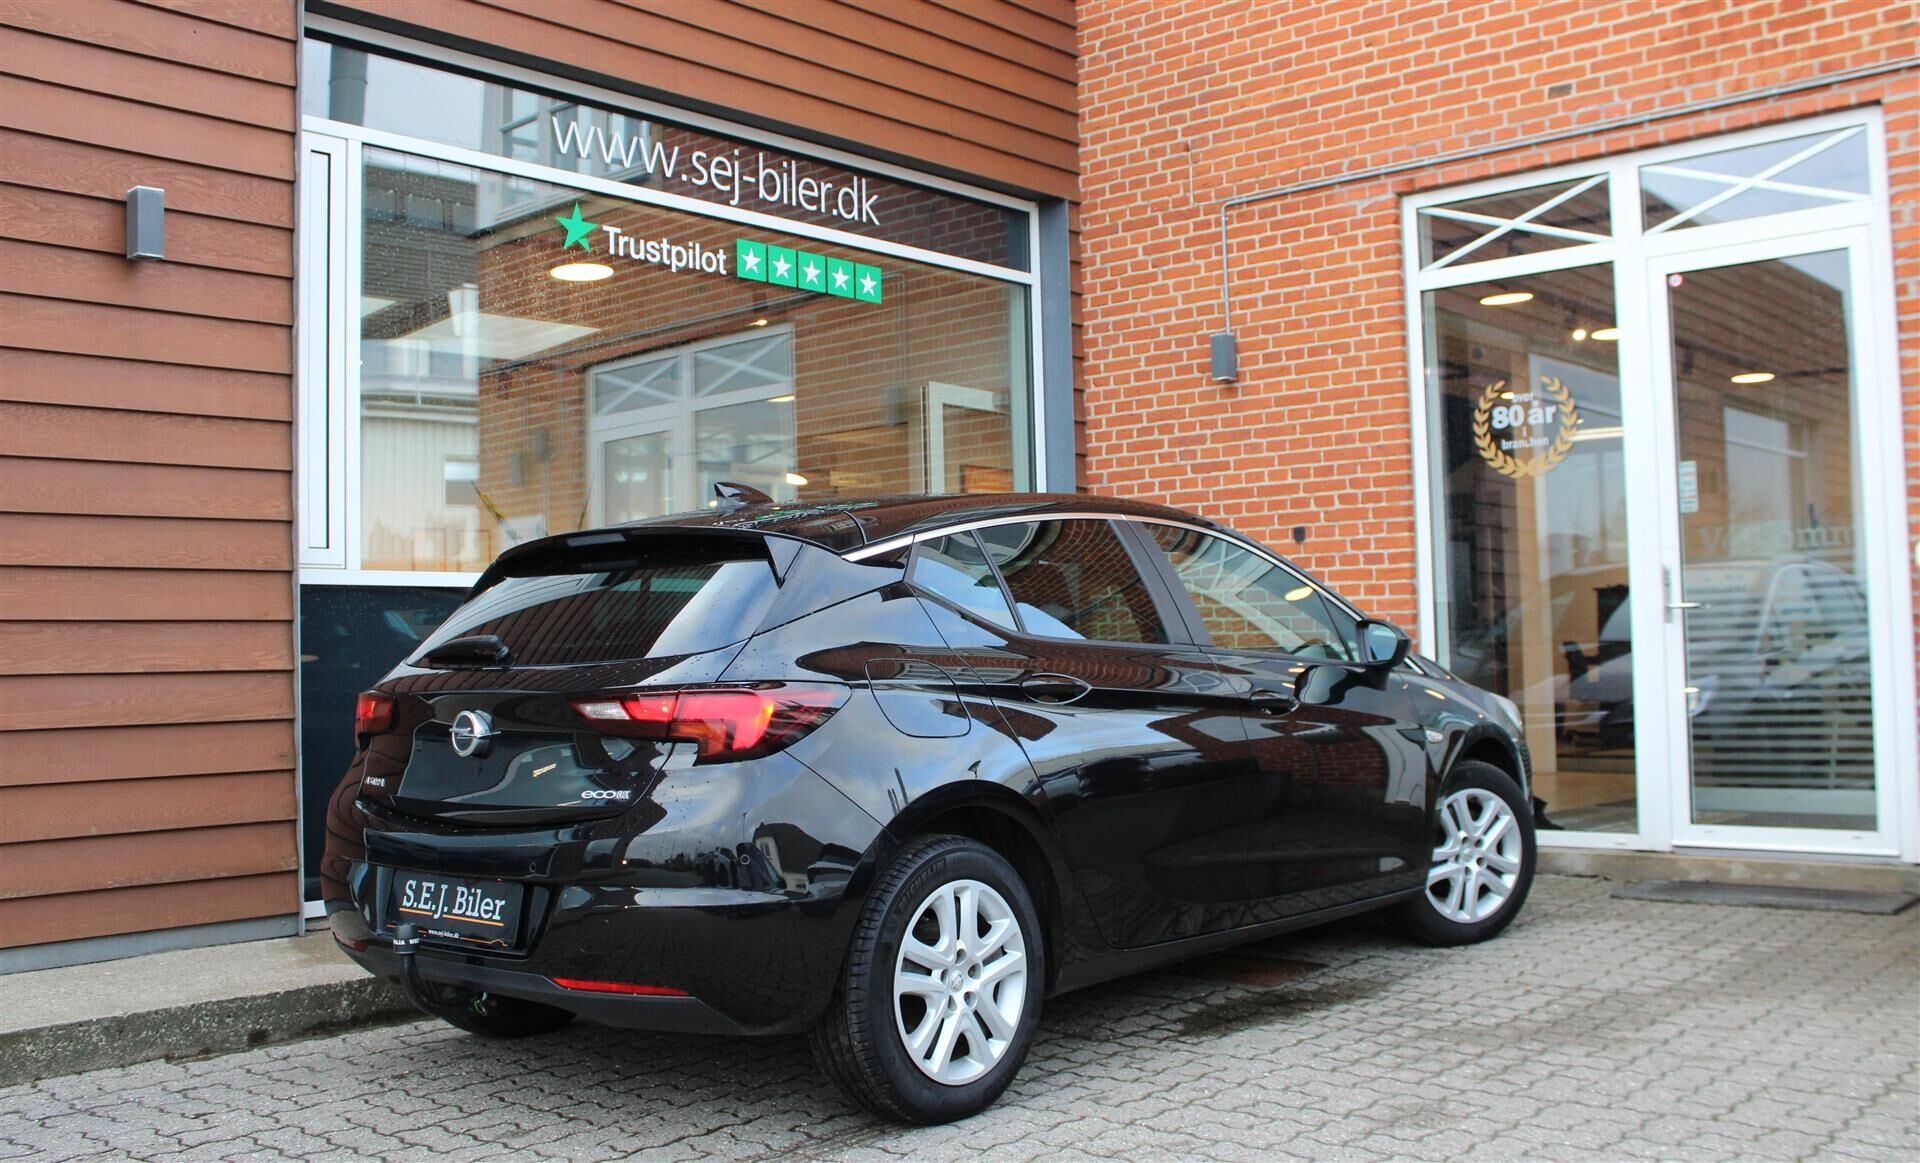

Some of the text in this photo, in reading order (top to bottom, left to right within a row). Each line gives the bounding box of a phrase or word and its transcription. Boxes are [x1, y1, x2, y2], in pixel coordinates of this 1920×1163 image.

[552, 116, 881, 226] www.sej-biler.dk
[602, 225, 728, 276] Trustpilot
[1491, 400, 1557, 430] 80 år
[1501, 438, 1550, 450] branchen
[402, 880, 506, 921] S.E.J. Biler
